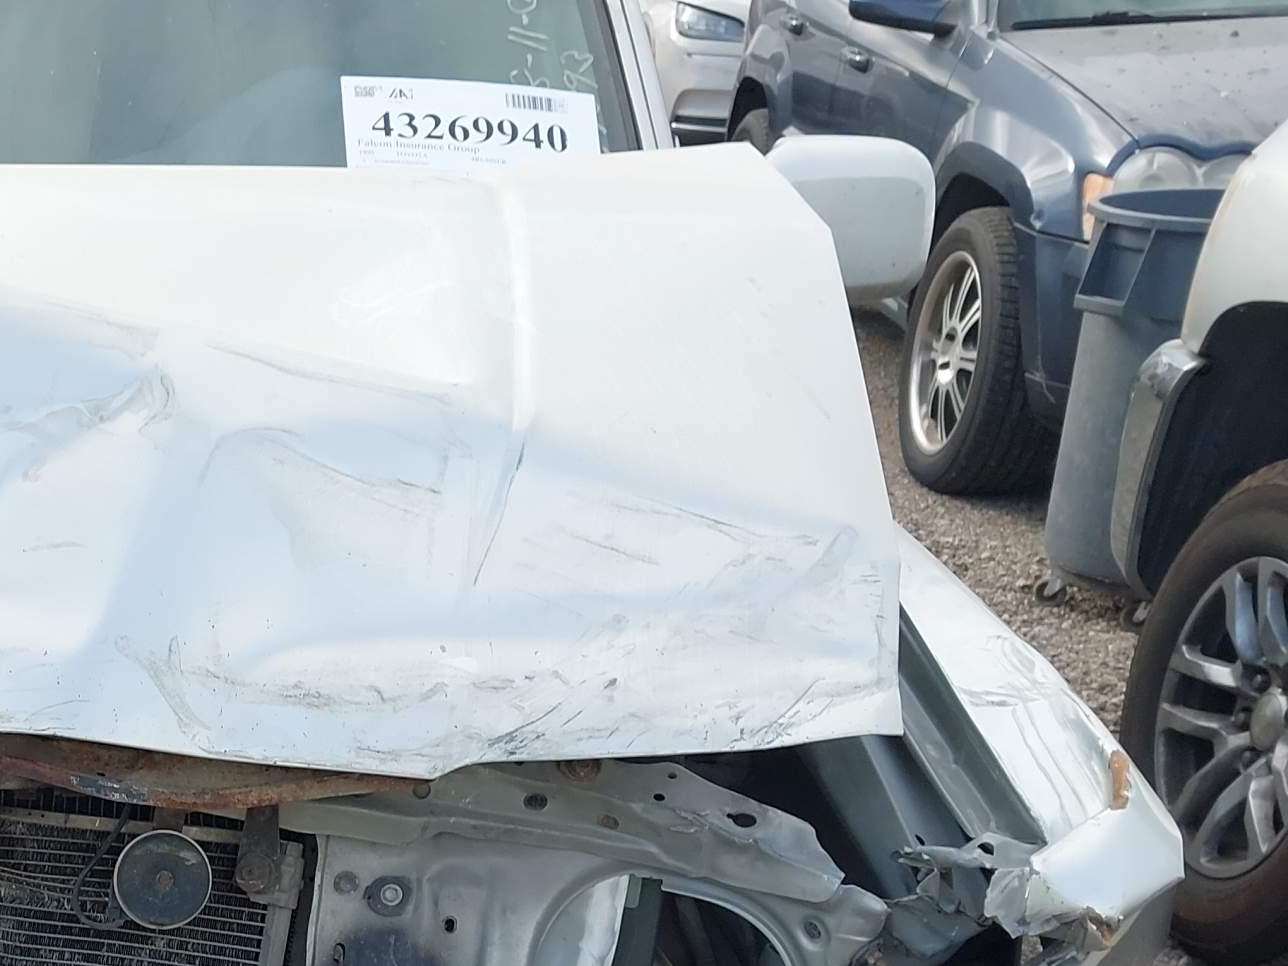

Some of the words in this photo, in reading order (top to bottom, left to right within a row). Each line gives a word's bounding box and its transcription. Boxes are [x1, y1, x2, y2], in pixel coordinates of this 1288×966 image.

[371, 111, 568, 153] 43269940
[396, 140, 444, 151] Insurance
[447, 143, 480, 154] Group
